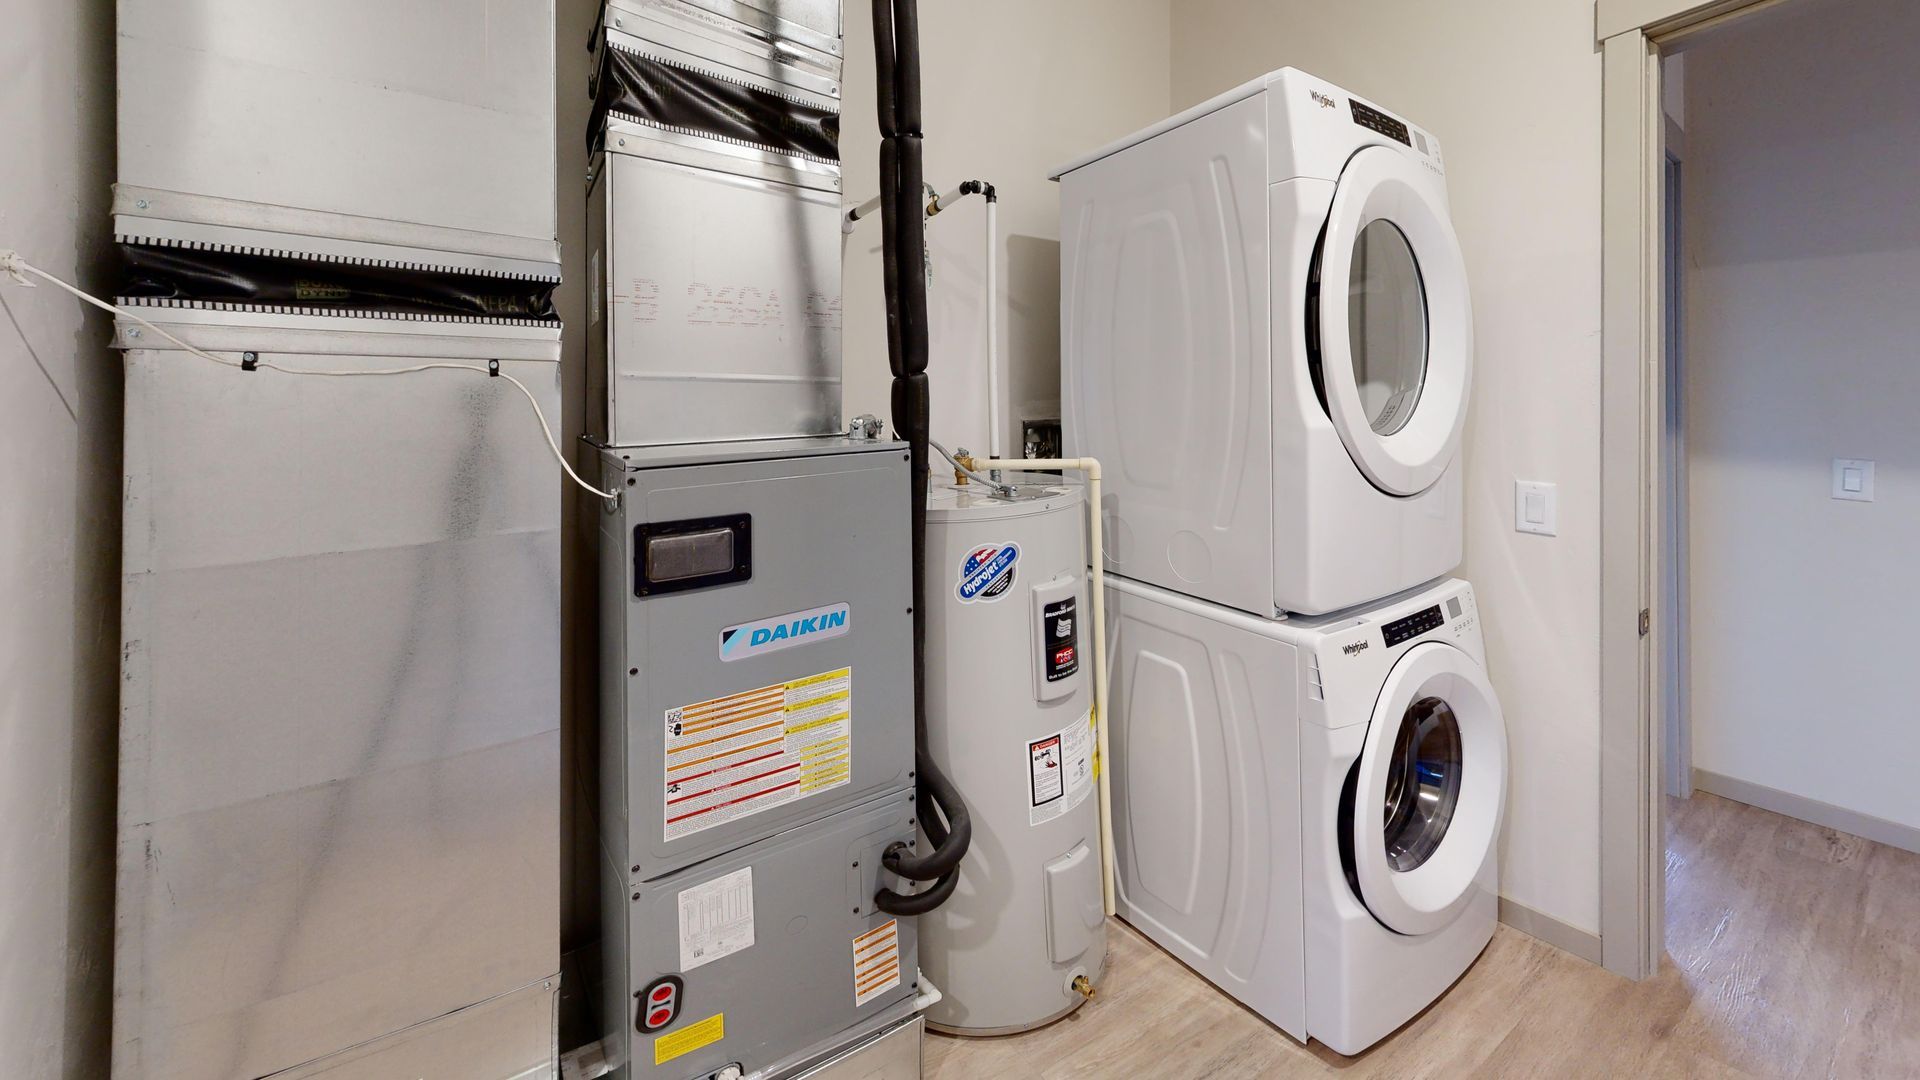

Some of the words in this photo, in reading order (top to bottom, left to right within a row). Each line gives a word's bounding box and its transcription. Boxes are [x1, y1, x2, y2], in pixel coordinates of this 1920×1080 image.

[1309, 89, 1336, 109] Whirlpool
[963, 561, 998, 595] Hydrojet
[750, 610, 847, 647] DAIKIN
[1342, 640, 1369, 657] Whirlpool
